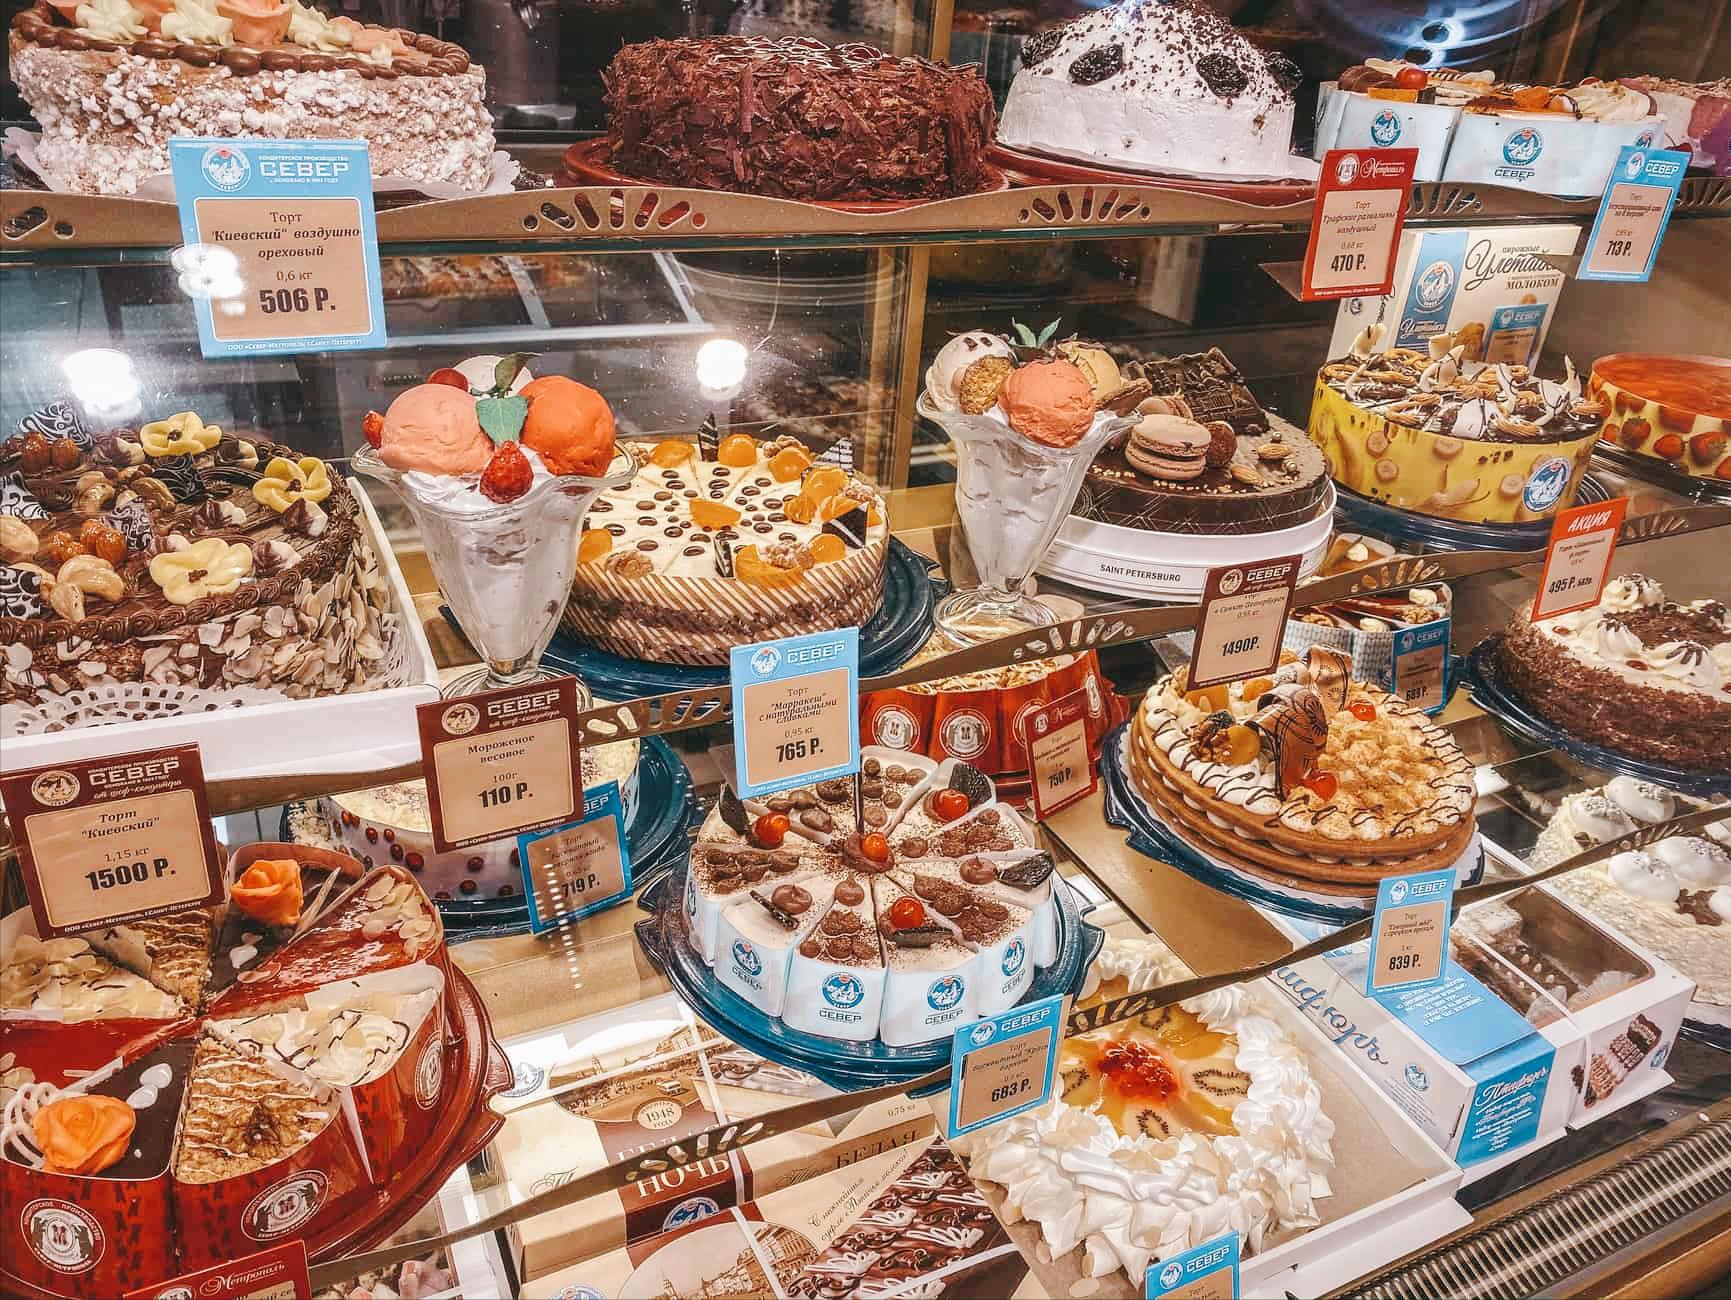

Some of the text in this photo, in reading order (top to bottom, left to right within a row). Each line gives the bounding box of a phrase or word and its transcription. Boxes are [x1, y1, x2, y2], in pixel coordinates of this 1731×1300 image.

[260, 161, 349, 177] СЕВЕР
[1494, 168, 1536, 178] СЕВЕР
[1645, 162, 1680, 175] СЕВЕР
[269, 211, 303, 224] Торт
[294, 226, 360, 243] воздушно
[258, 244, 325, 261] ореховый
[1605, 240, 1632, 256] 713 Р.
[1330, 253, 1367, 272] 470 Р.
[276, 270, 312, 282] 0,6 кг
[259, 286, 337, 314] 506 Р.
[1567, 510, 1613, 533] АКЦИЯ
[1100, 564, 1181, 582] SAINT PETERSBURG
[1247, 566, 1292, 583] СЕВЕР
[787, 643, 845, 664] СЕВЕР
[1221, 636, 1260, 657] 1490Р.
[771, 692, 828, 711] "Марракеш"
[787, 687, 808, 698] Торт
[487, 692, 560, 717] СЕВЕР
[765, 699, 838, 721] натуральными
[467, 734, 536, 755] Мороженое
[776, 737, 824, 763] 765 Р.
[480, 748, 526, 764] весовое
[89, 760, 180, 787] СЕВЕР
[492, 771, 519, 784] 100г
[1047, 771, 1065, 790] 750
[478, 781, 534, 808] 110 Р.
[99, 809, 137, 824] Торт
[81, 816, 160, 840] "Киевский"
[104, 846, 150, 863] 1,15 кг
[85, 857, 177, 891] 1500 Р.
[561, 873, 601, 899] 719 Р.
[1411, 882, 1448, 895] СЕВЕР
[1411, 954, 1422, 968] Р.
[819, 1009, 863, 1022] СЕВЕР
[925, 1009, 964, 1025] СЕВЕР
[1001, 1008, 1051, 1032] СЕВЕР
[991, 1078, 1032, 1103] 683 Р.
[645, 1106, 675, 1123] 1948
[888, 1105, 905, 1118] 0,75
[637, 1157, 730, 1198] НОЧЬ
[1186, 1246, 1230, 1273] СЕВЕР
[199, 1263, 286, 1296] Метрополь
